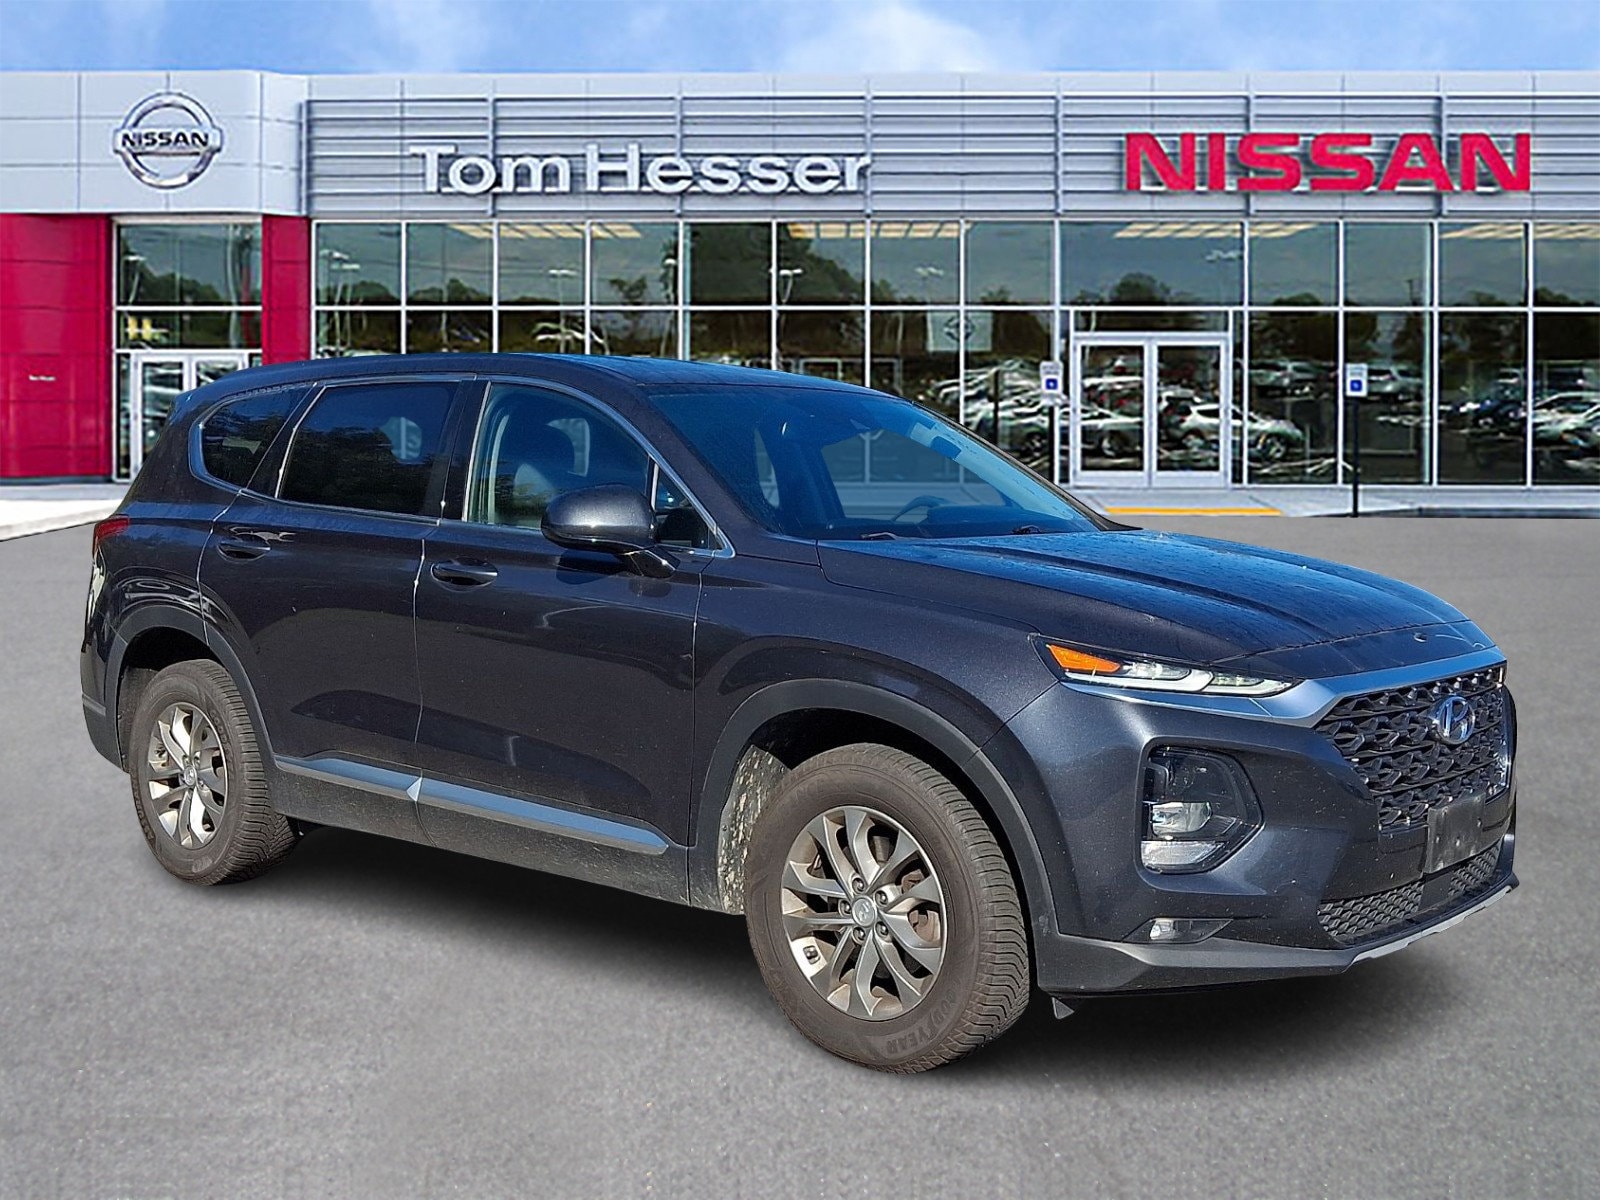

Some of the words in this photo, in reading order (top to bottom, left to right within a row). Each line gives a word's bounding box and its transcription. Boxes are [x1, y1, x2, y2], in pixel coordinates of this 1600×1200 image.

[121, 131, 209, 148] NISSAN
[1125, 132, 1531, 191] NISSAN
[408, 143, 571, 195] Tom
[584, 142, 871, 195] Hesser
